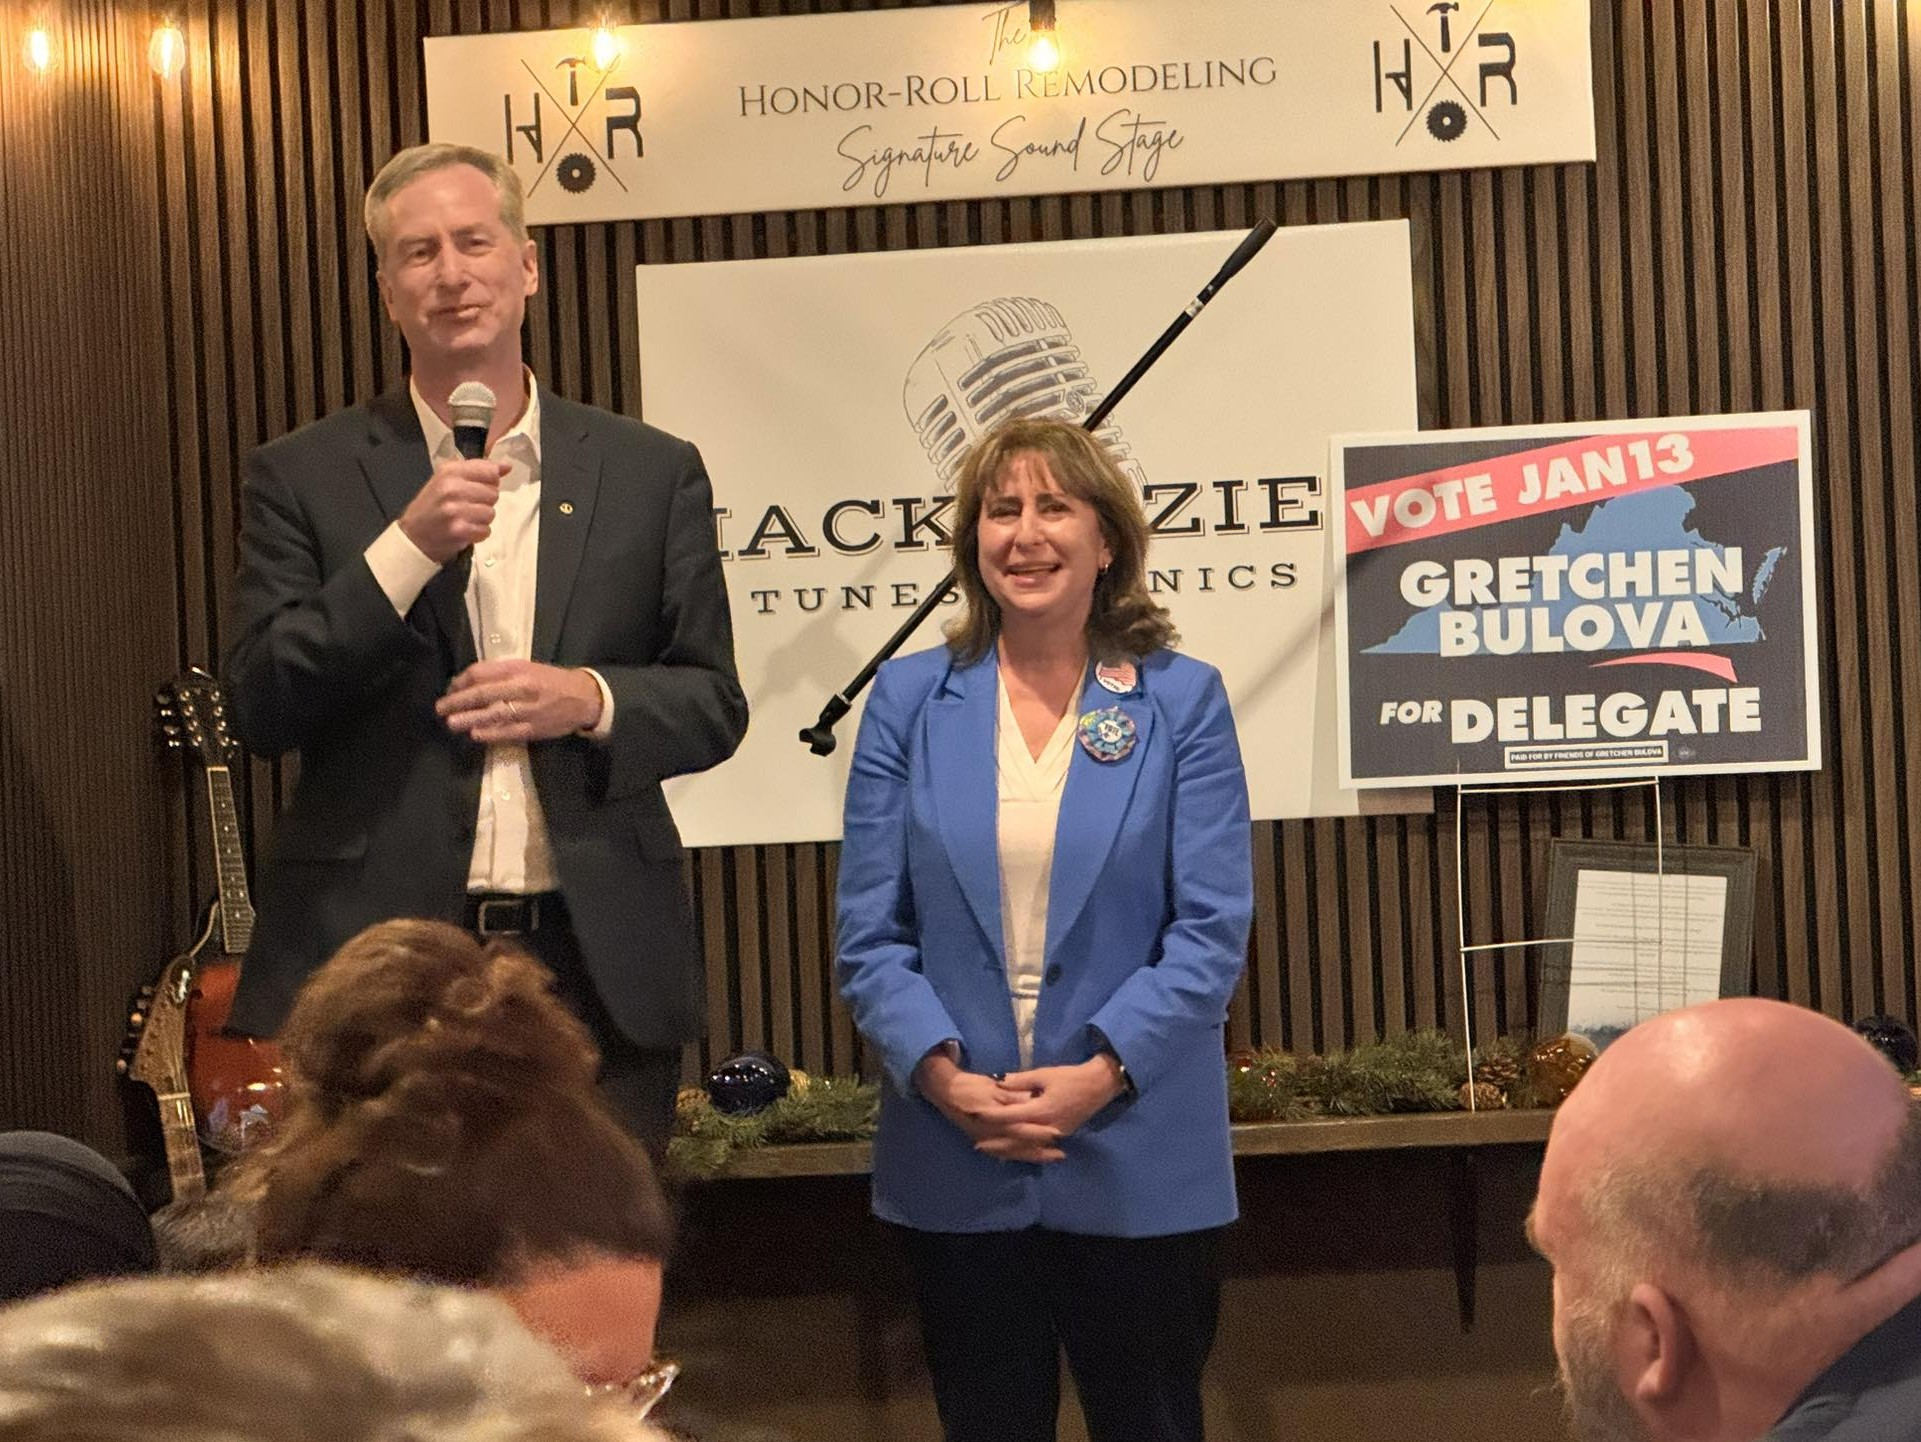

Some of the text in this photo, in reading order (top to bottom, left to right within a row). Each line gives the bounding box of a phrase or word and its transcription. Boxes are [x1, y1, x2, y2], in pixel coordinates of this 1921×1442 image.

[982, 0, 1026, 65] The
[738, 57, 1277, 116] HONOR-ROLL REMODELING
[837, 108, 1184, 198] Signature Sound Stage
[1351, 473, 1497, 537] VOTE
[1399, 547, 1743, 607] GRETCHEN
[1439, 600, 1710, 657] BULOVA
[1380, 687, 1762, 744] FOR DELEGATE
[1510, 748, 1662, 761] PAID FOR BY FRIENDS OF GRETCHEN BULOVA
